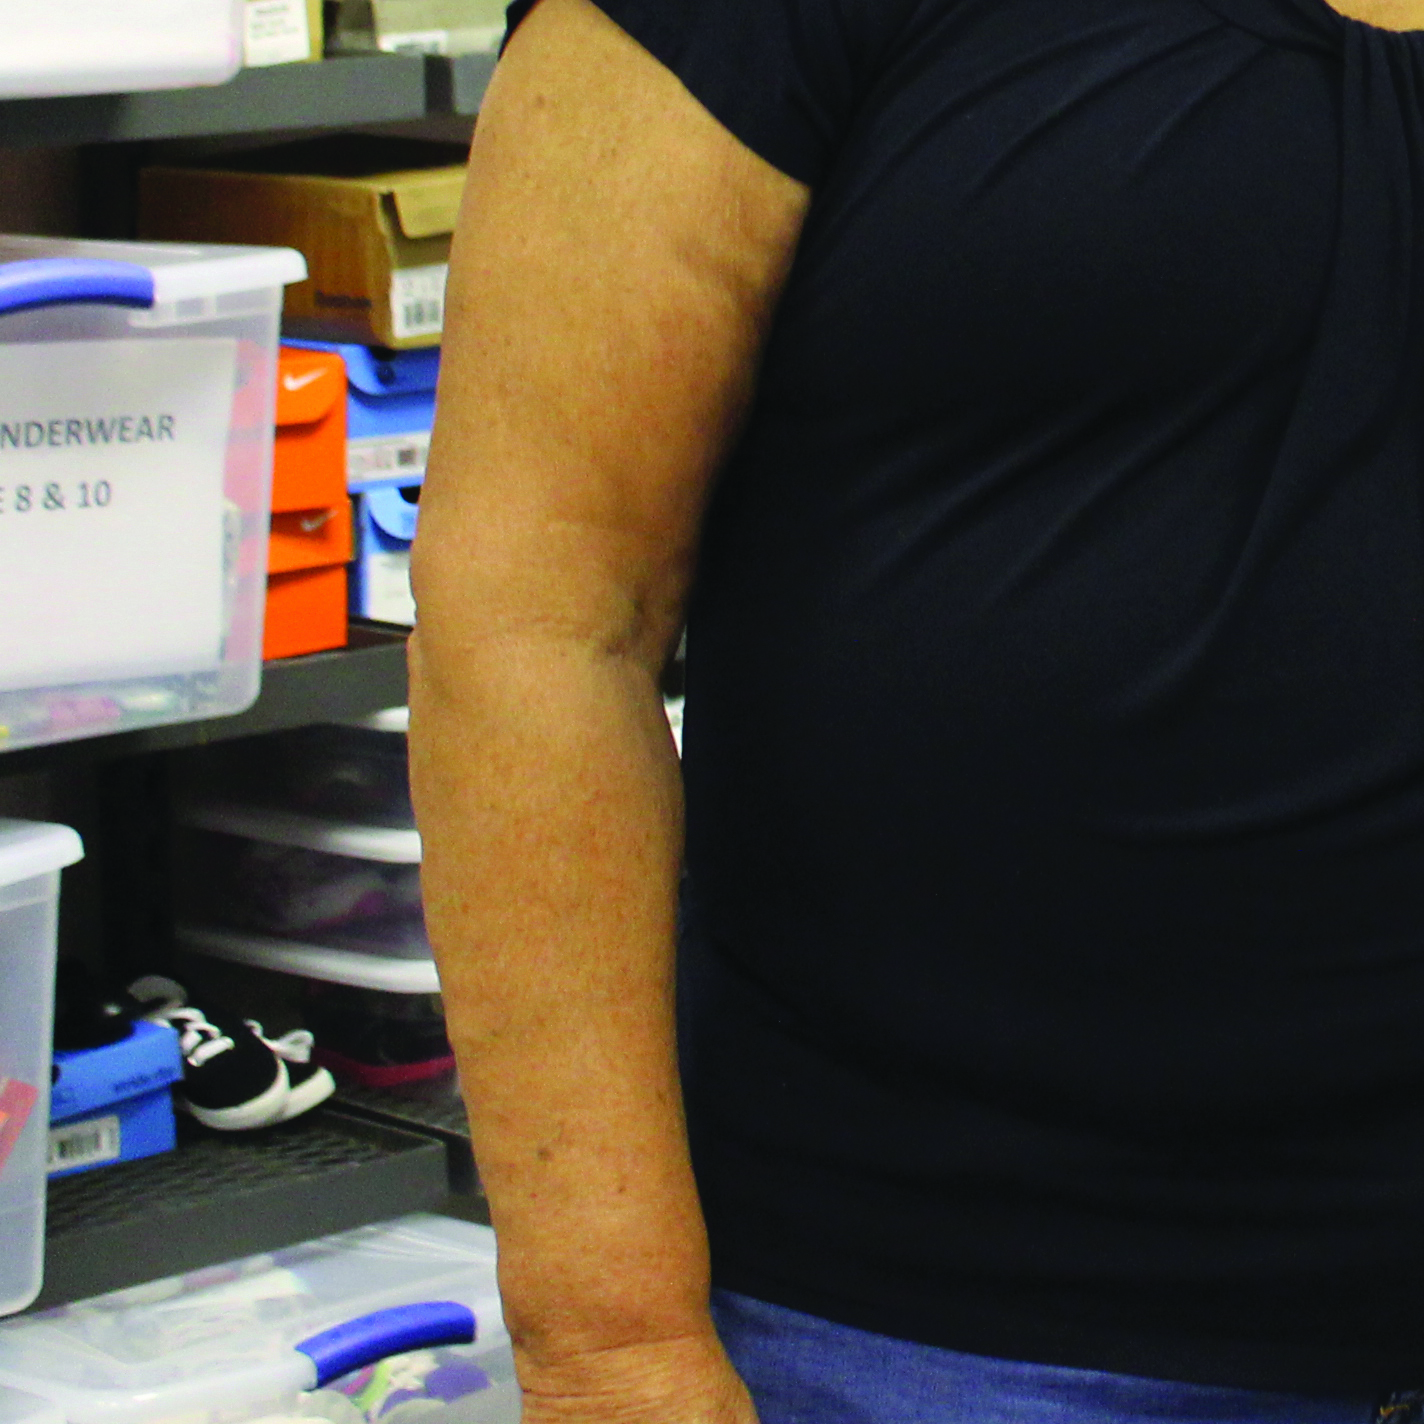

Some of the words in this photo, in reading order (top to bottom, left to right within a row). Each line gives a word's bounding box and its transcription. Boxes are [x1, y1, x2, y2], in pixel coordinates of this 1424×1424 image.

[15, 484, 31, 513] 8
[42, 482, 65, 511] &
[78, 480, 112, 509] 10
